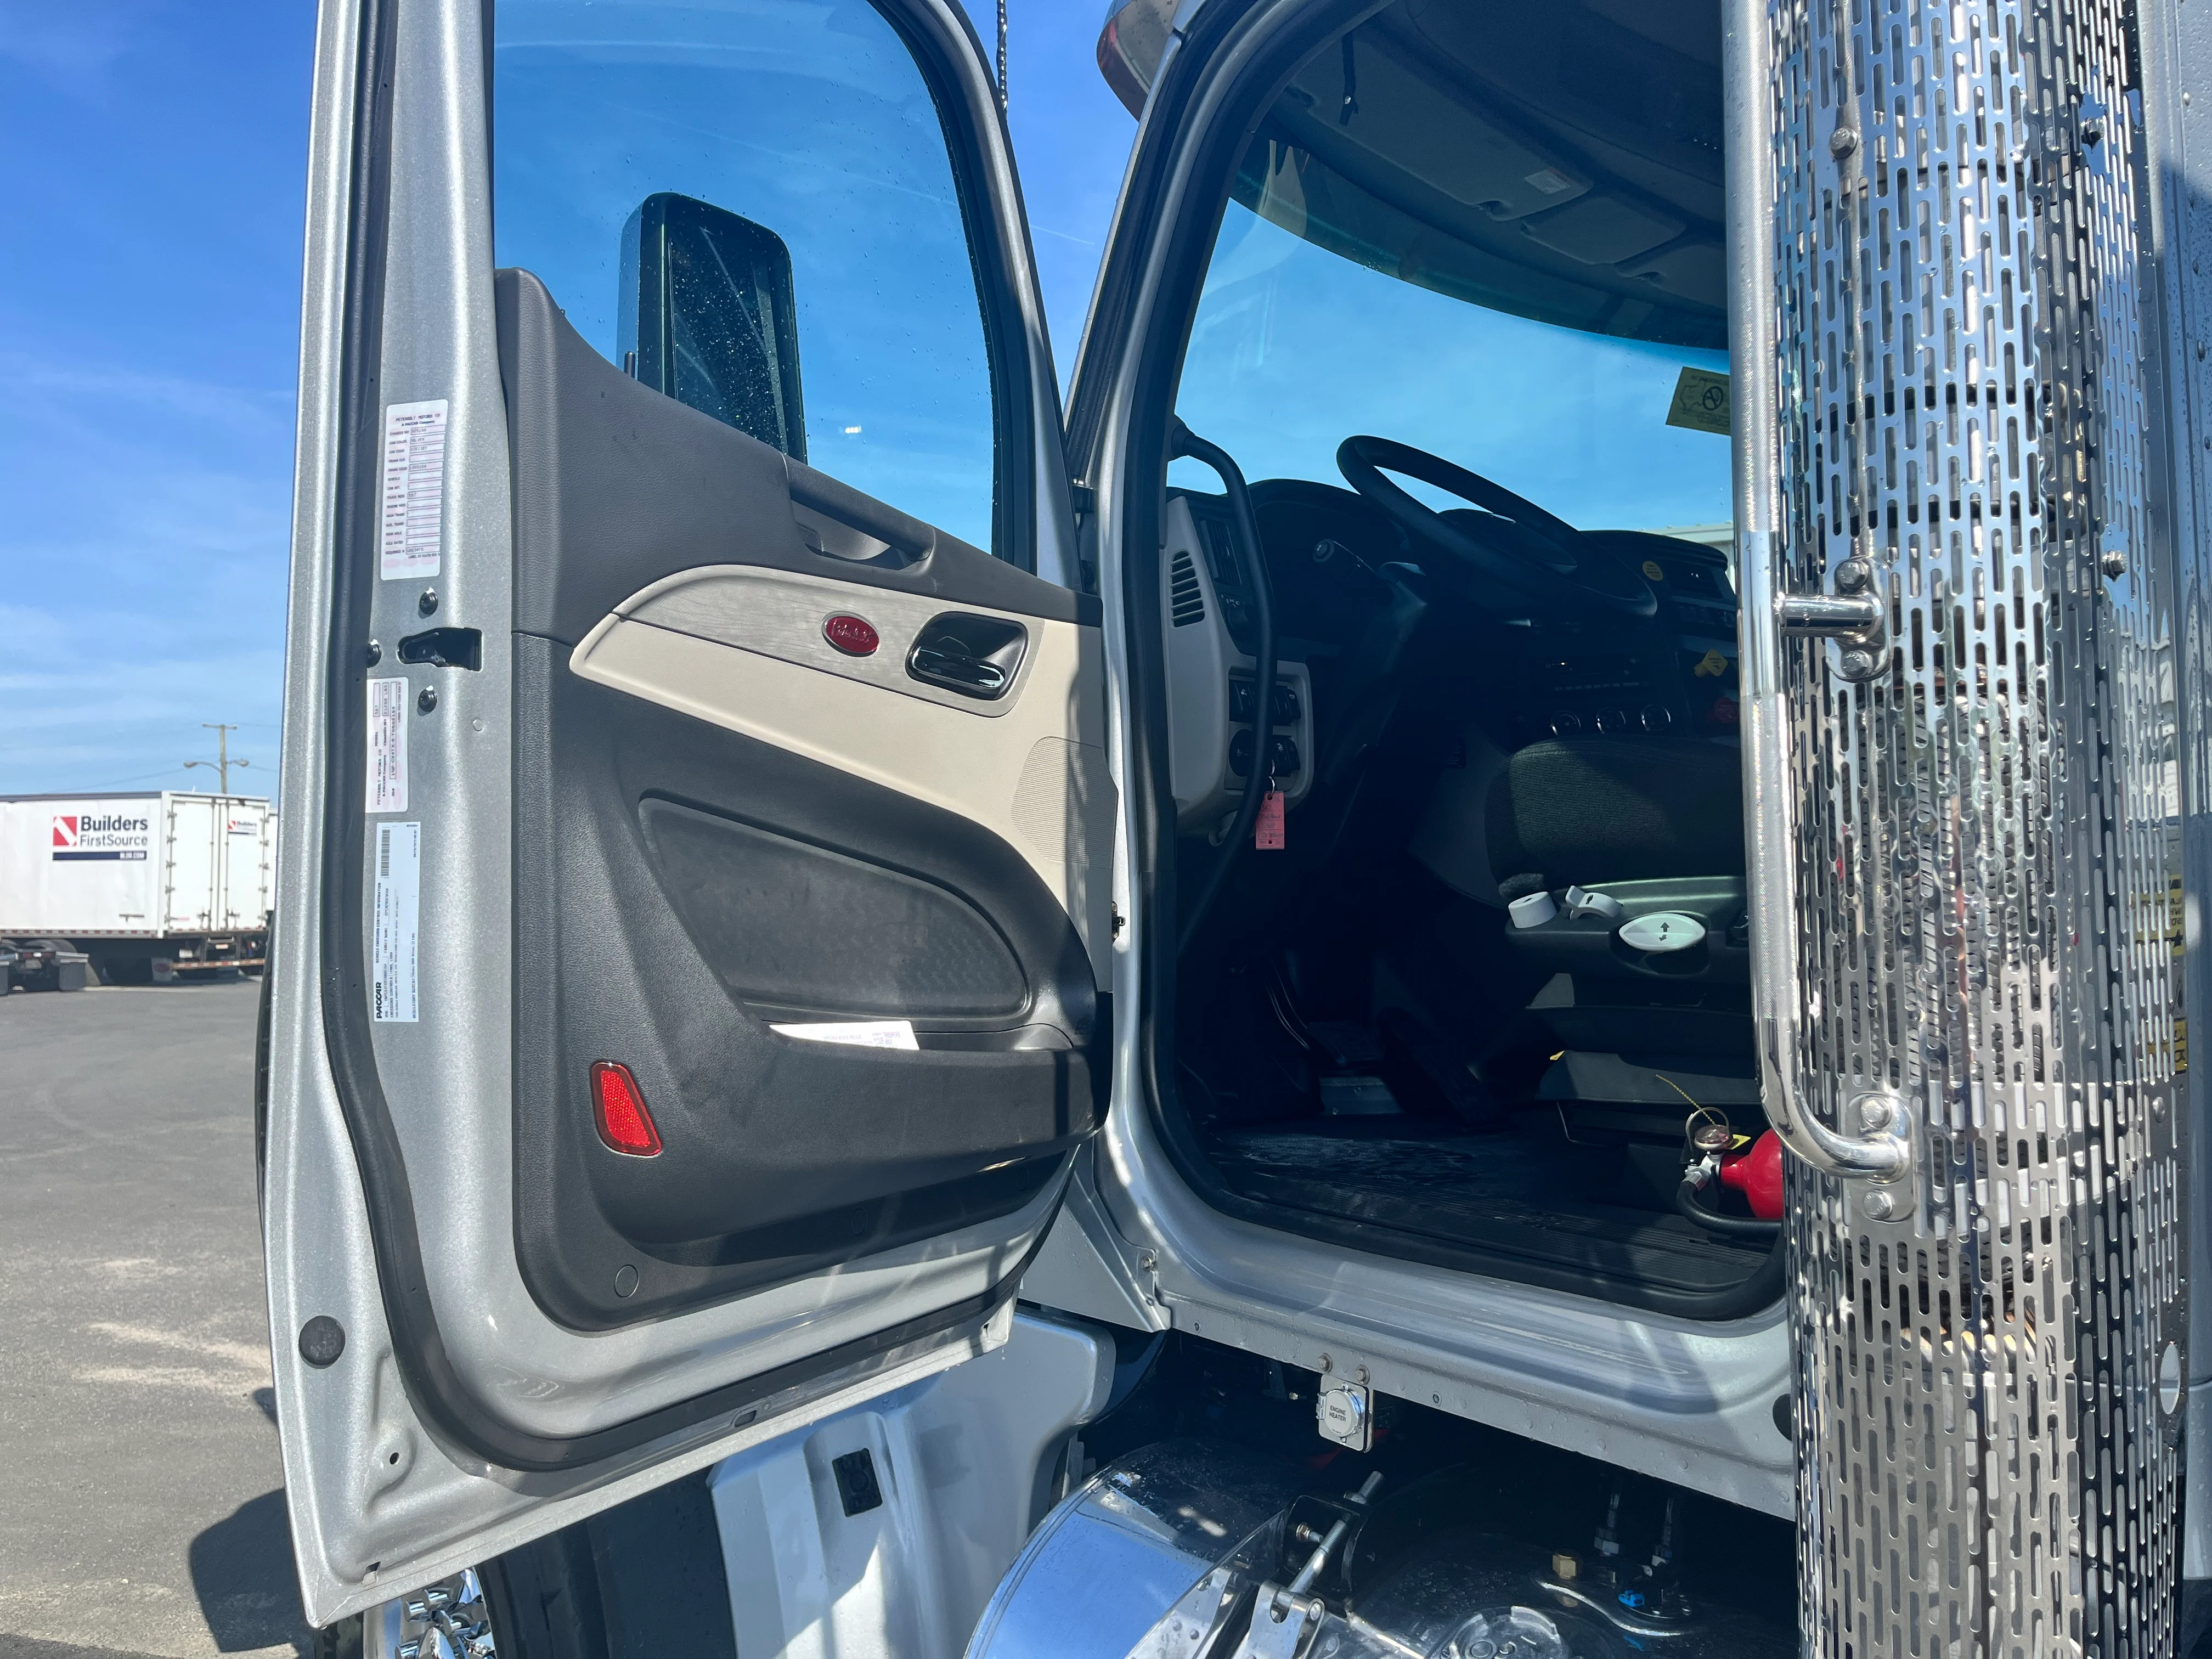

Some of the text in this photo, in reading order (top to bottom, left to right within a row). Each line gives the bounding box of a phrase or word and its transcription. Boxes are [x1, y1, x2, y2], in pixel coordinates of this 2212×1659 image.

[81, 815, 148, 831] Builders
[80, 834, 148, 847] FirstSource
[1330, 1406, 1346, 1415] ENGINE
[1329, 1412, 1346, 1422] HEATER
